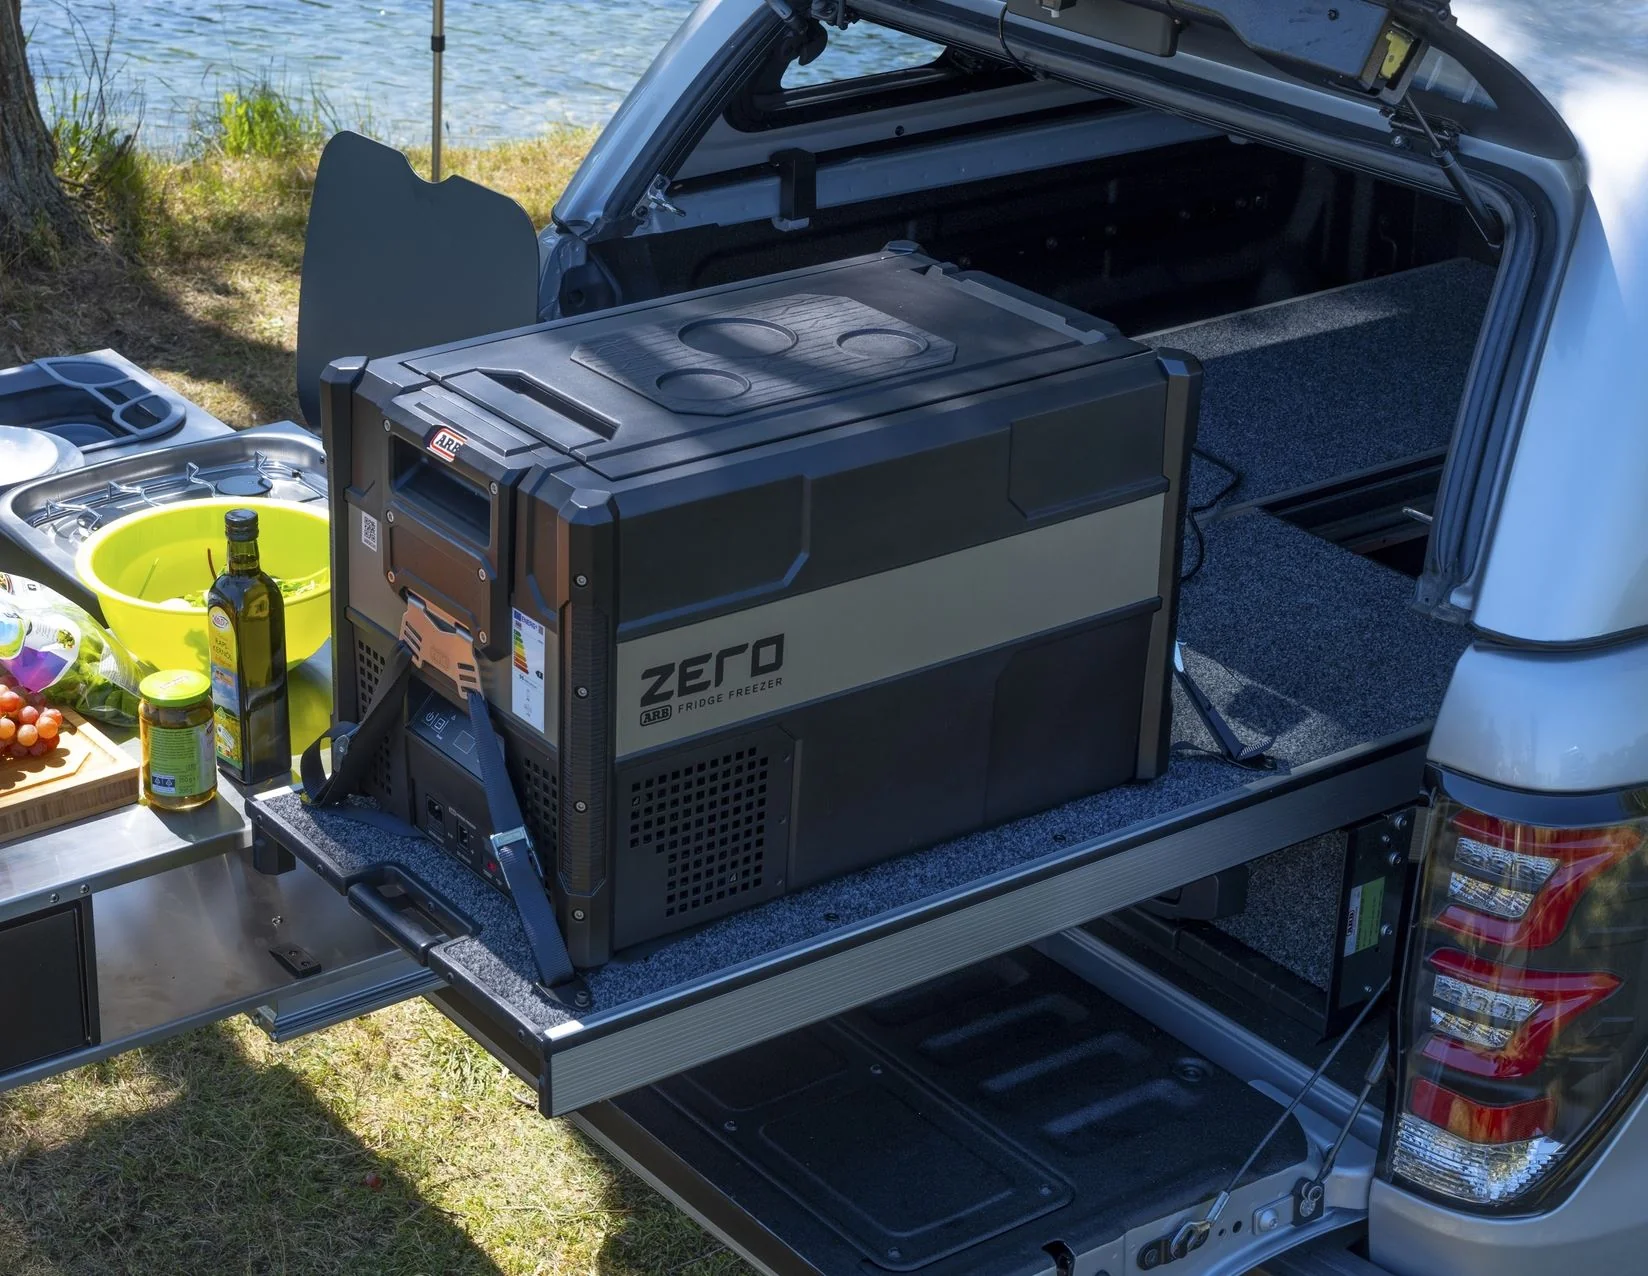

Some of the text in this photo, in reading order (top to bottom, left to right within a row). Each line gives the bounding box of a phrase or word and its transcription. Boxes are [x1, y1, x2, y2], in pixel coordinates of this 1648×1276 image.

[640, 633, 785, 708] ZERO
[643, 677, 783, 724] ARB FRIDGE FREEZER
